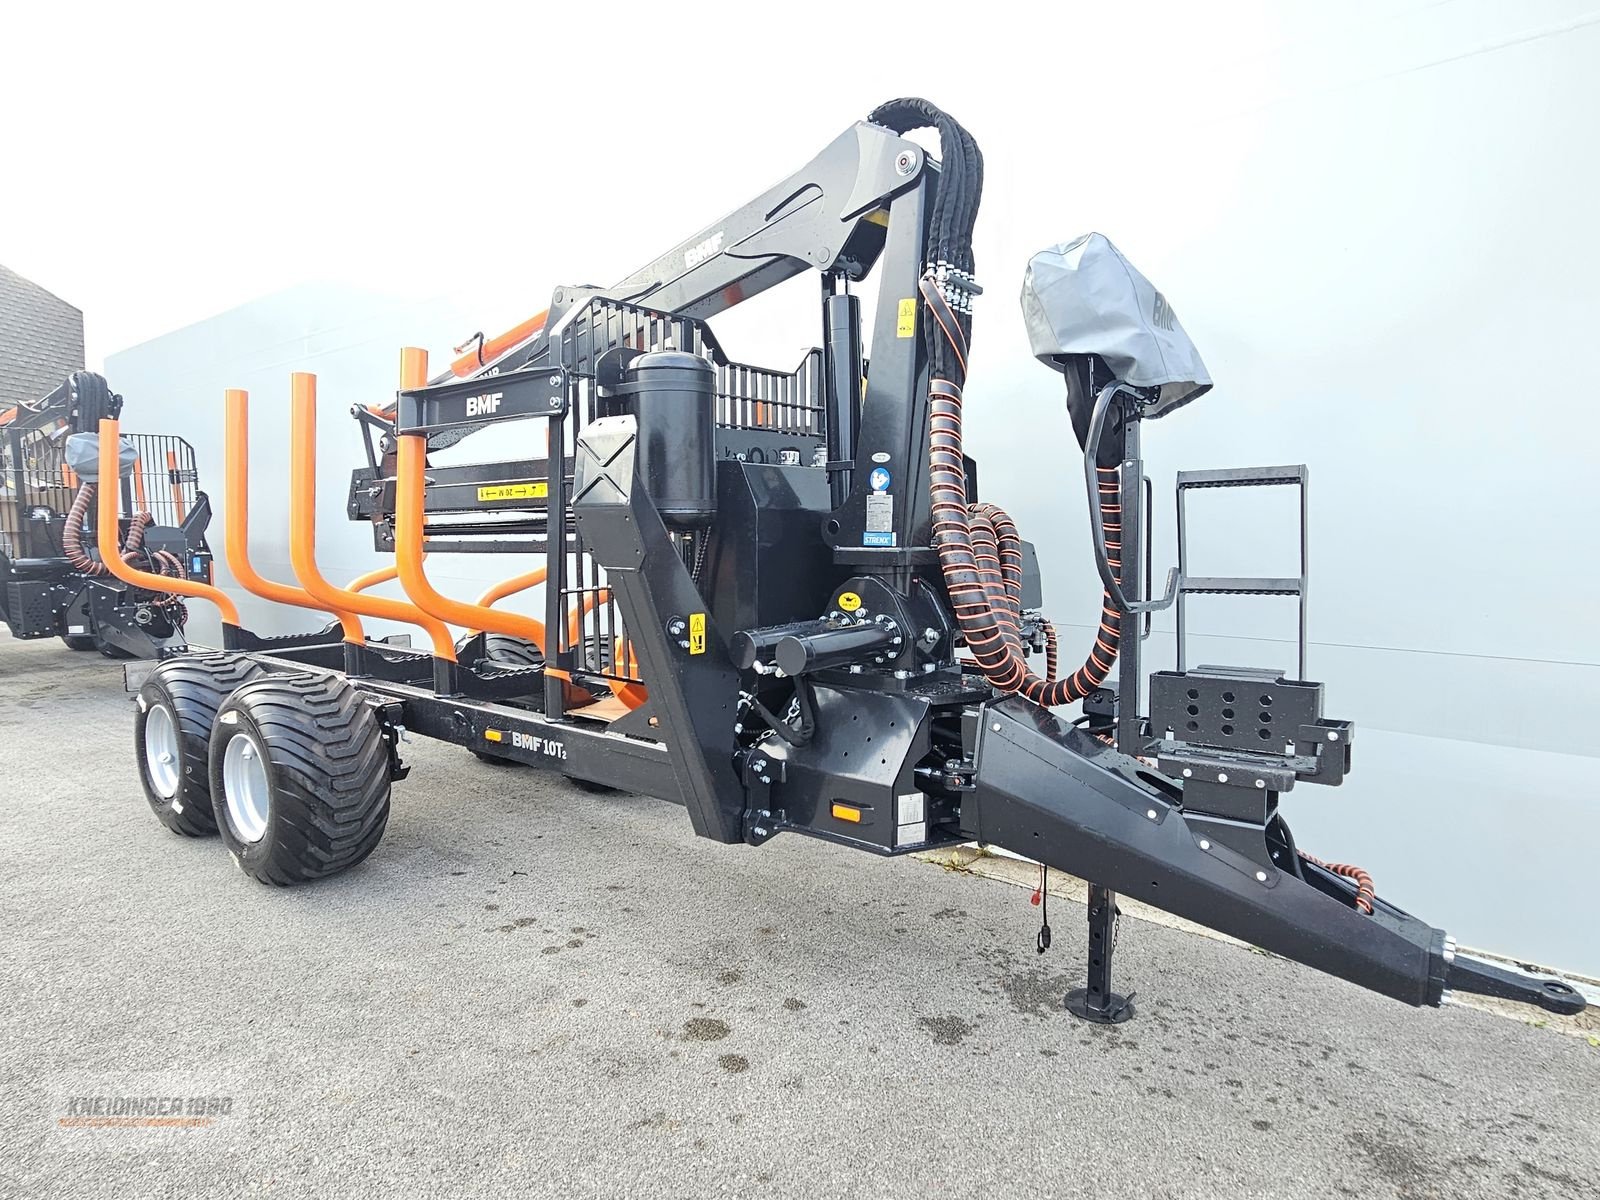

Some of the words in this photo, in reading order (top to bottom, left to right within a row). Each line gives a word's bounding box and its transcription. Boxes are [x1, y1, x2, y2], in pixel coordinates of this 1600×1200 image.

[684, 231, 724, 269] BMF
[466, 392, 503, 417] BMF
[512, 731, 542, 752] BMF
